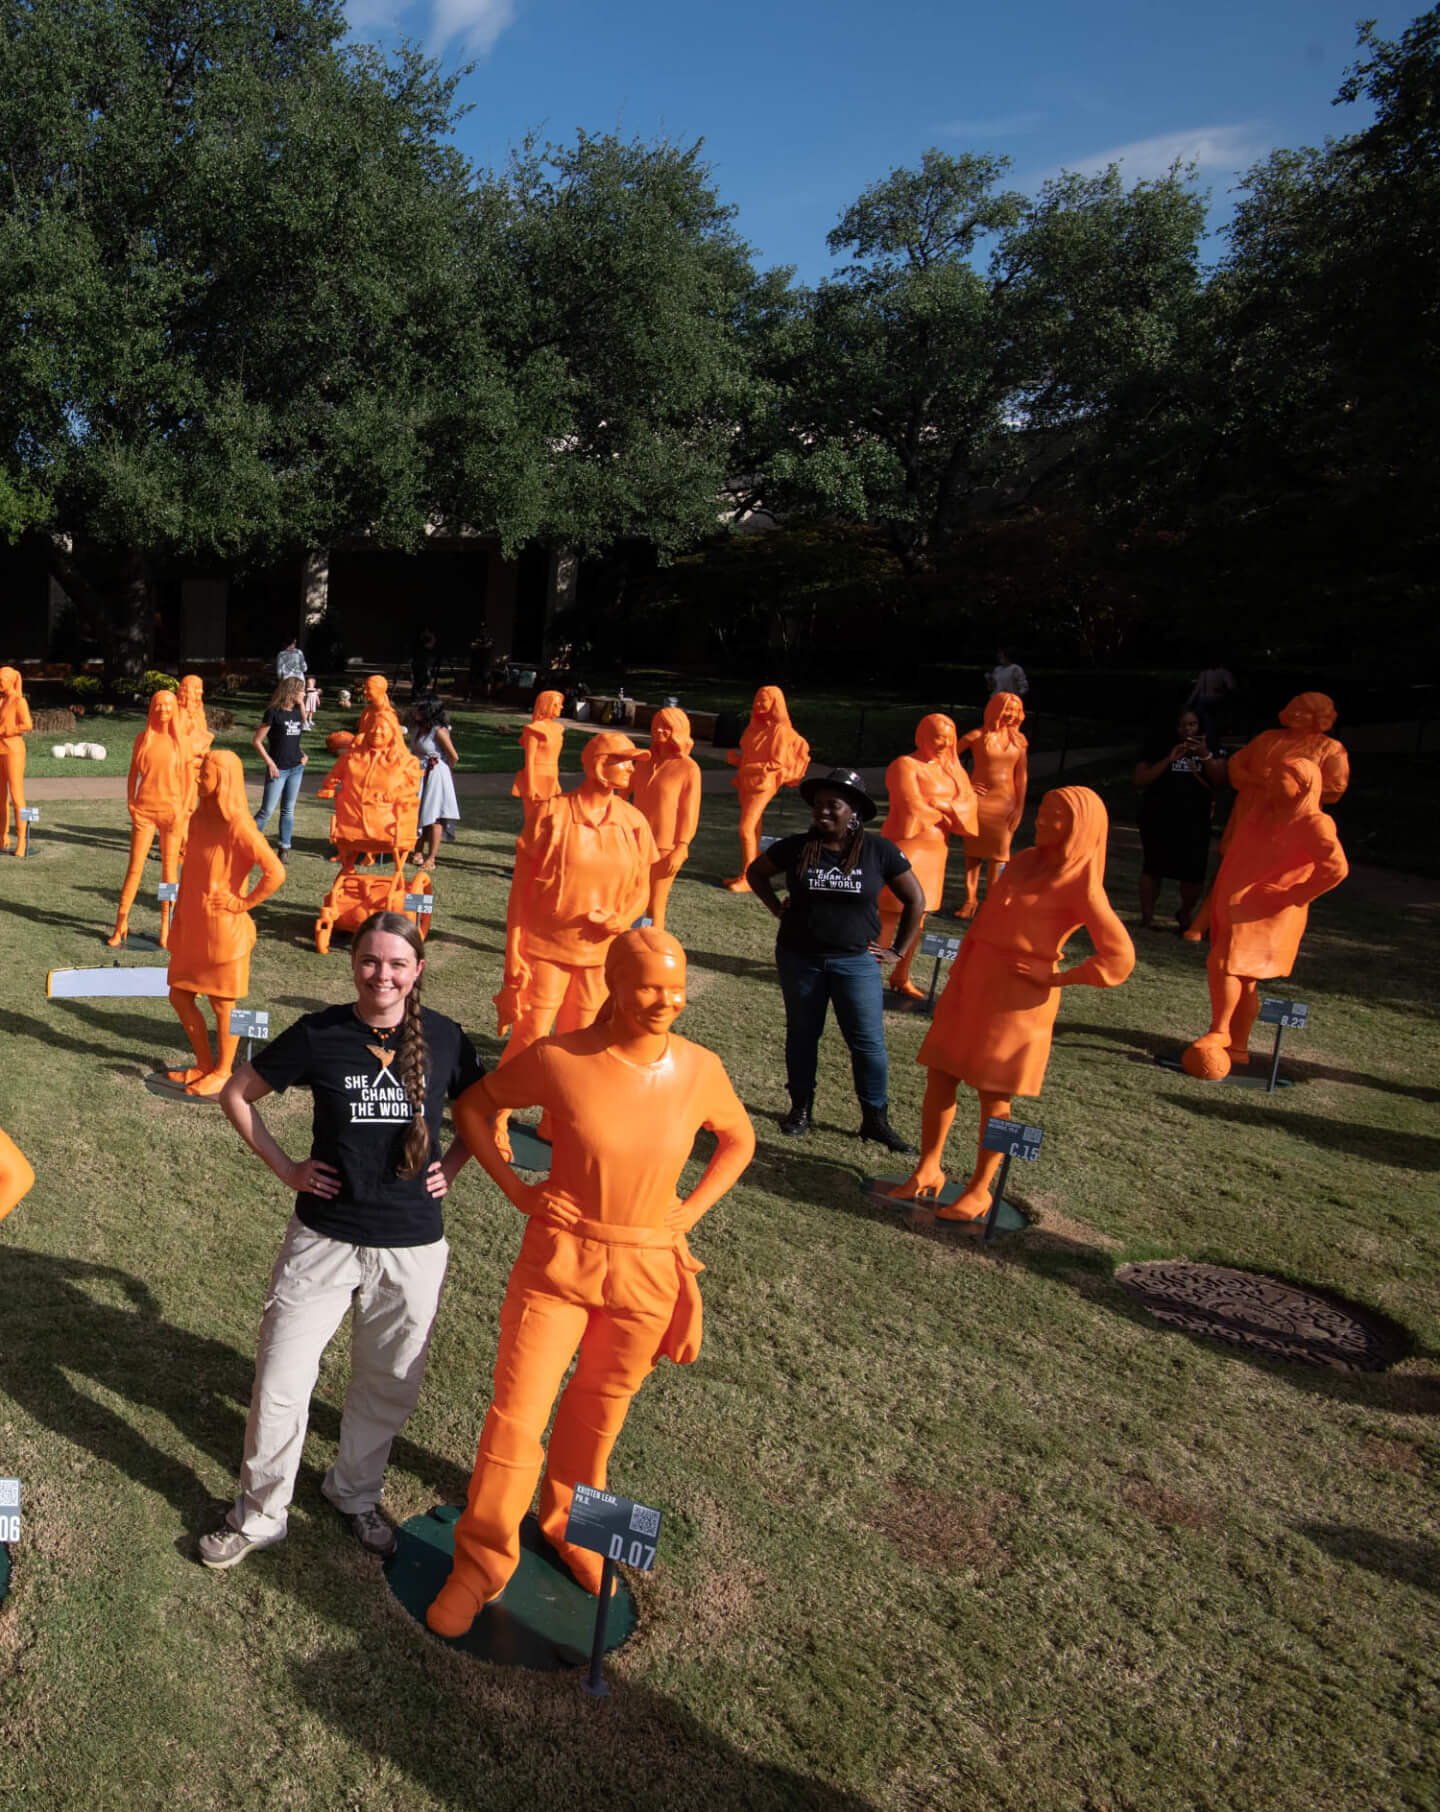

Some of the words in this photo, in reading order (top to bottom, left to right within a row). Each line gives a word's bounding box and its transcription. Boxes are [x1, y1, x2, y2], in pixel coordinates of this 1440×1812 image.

[808, 878, 827, 888] THE
[829, 880, 862, 890] WORLD
[1280, 1015, 1305, 1030] B.23
[248, 1025, 269, 1039] C.13
[344, 1075, 369, 1089] SHE
[349, 1102, 375, 1117] THE
[1009, 1142, 1040, 1162] C.15
[607, 1533, 657, 1572] D.07
